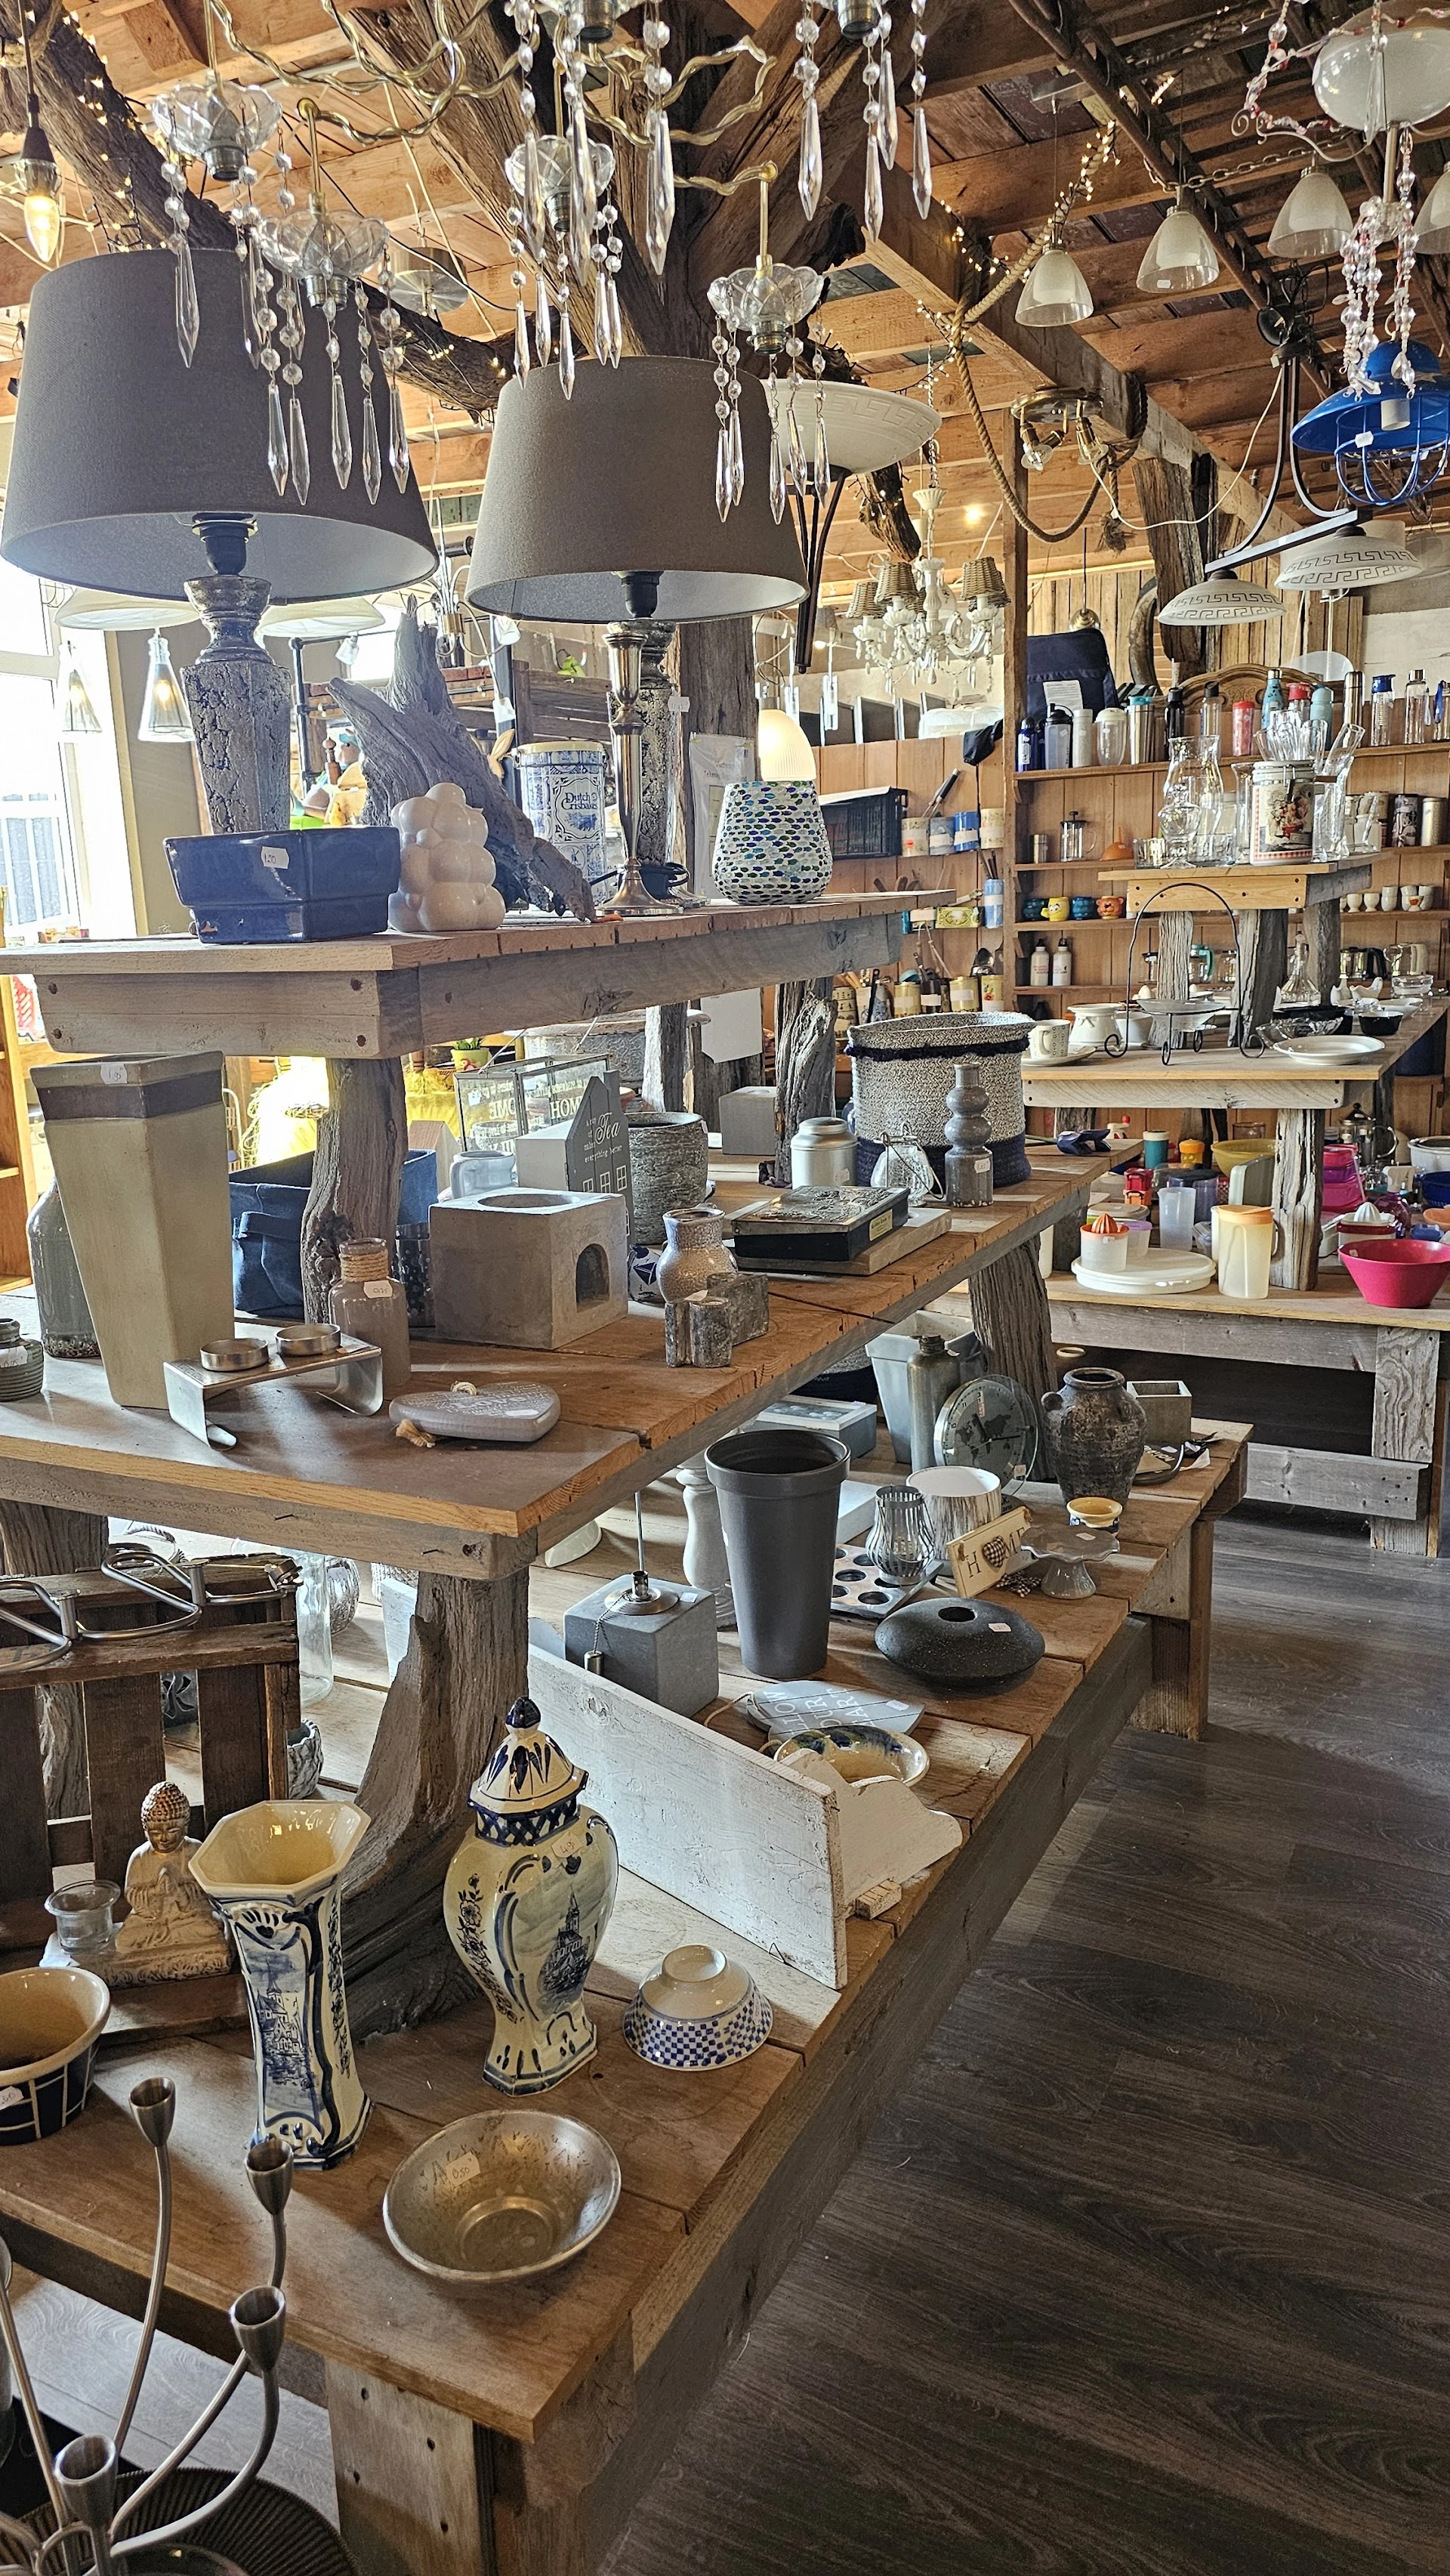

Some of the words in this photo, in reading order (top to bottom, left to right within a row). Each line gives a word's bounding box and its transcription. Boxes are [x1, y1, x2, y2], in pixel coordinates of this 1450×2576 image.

[565, 792, 591, 804] Dutch
[551, 1096, 582, 1119] HOM
[595, 1112, 620, 1144] Tea
[455, 1396, 526, 1409] Love
[804, 1697, 843, 1728] OUR
